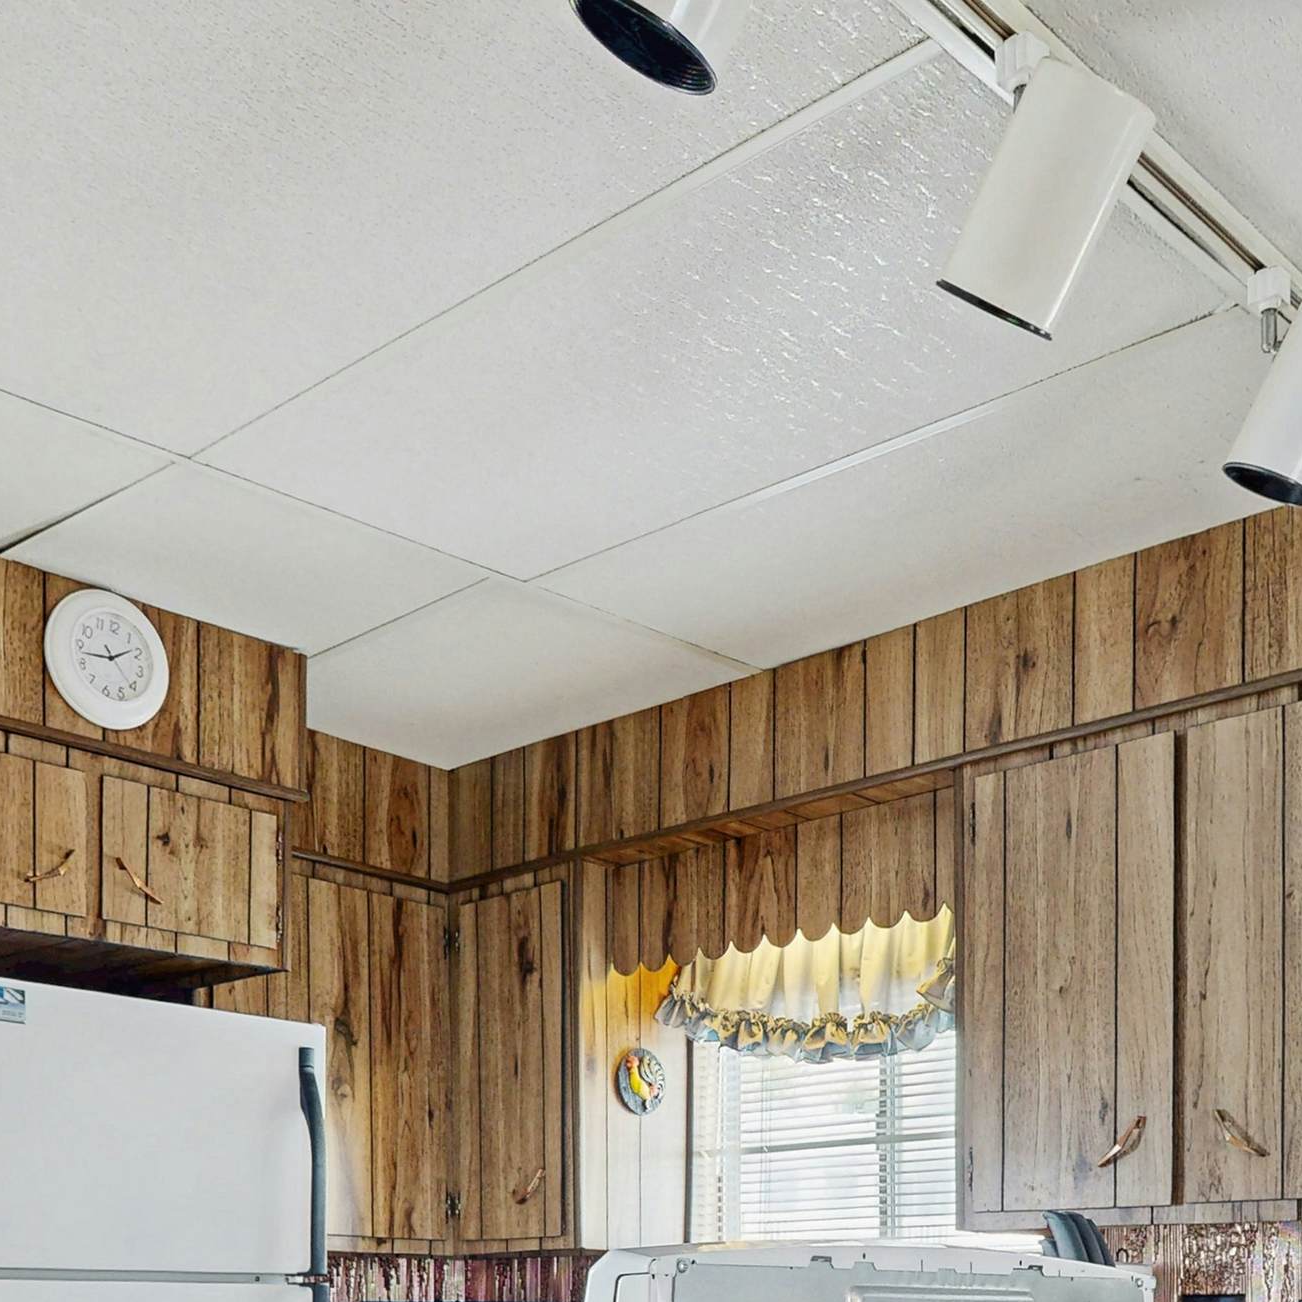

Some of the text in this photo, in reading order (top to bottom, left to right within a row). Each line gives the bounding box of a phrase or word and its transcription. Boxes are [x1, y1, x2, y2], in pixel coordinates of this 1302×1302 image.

[82, 623, 93, 639] 10
[96, 617, 104, 631] 11
[109, 619, 120, 635] 12
[134, 647, 143, 661] 2
[136, 665, 143, 678] 3
[102, 685, 110, 698] 6
[117, 686, 125, 700] 5
[129, 680, 137, 692] 4
